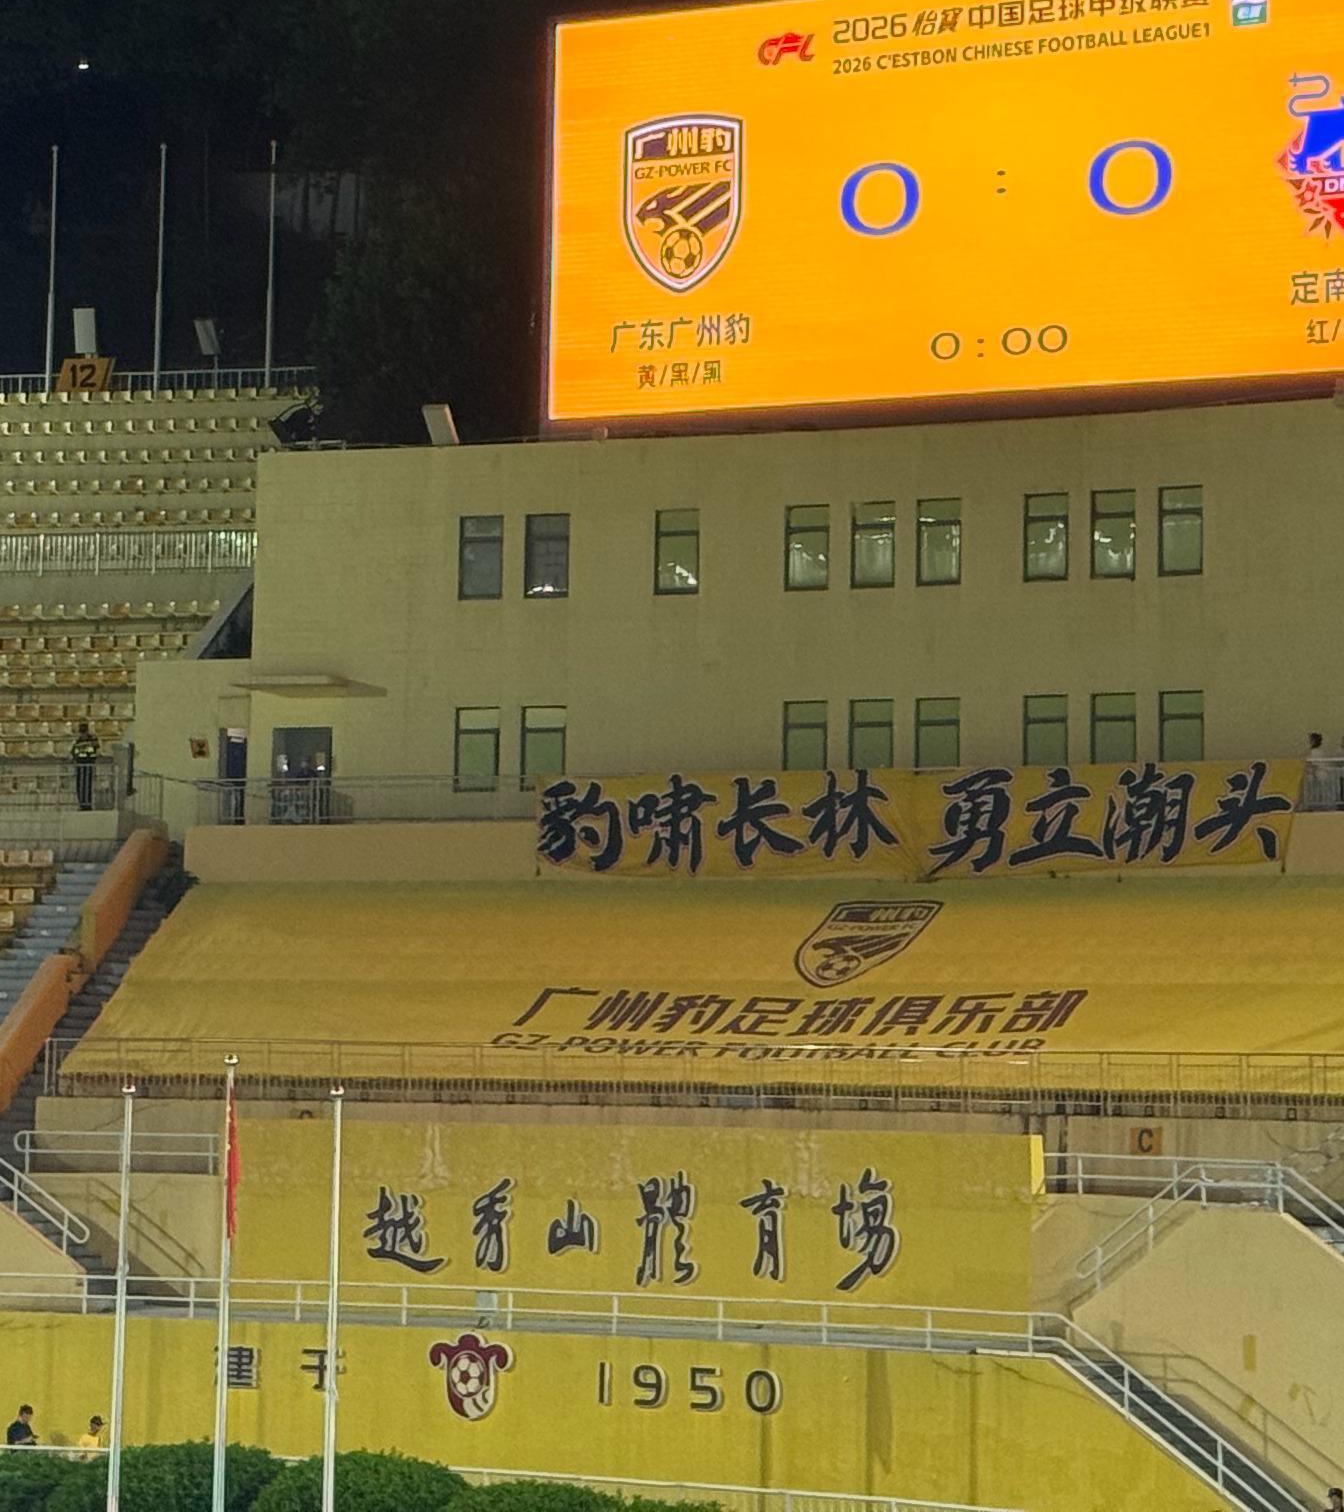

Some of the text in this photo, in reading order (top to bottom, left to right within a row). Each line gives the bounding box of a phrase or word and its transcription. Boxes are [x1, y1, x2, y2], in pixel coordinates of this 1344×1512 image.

[833, 56, 871, 74] 2026
[876, 47, 957, 70] C'ESTBON
[962, 39, 1033, 61] CHINESE
[1038, 30, 1127, 54] FOOTBALL
[634, 125, 732, 159] 广州豹
[714, 159, 732, 173] FC
[840, 162, 919, 236] 0
[1089, 140, 1172, 215] 0
[610, 313, 750, 353] 广东广州豹
[70, 364, 97, 388] 12
[538, 762, 1293, 876] 豹啸长林 勇立潮头
[513, 986, 1088, 1036] 广州豹足球俱乐部
[935, 1038, 1046, 1059] CLUB
[1137, 1128, 1153, 1153] C
[597, 1361, 779, 1414] 1950
